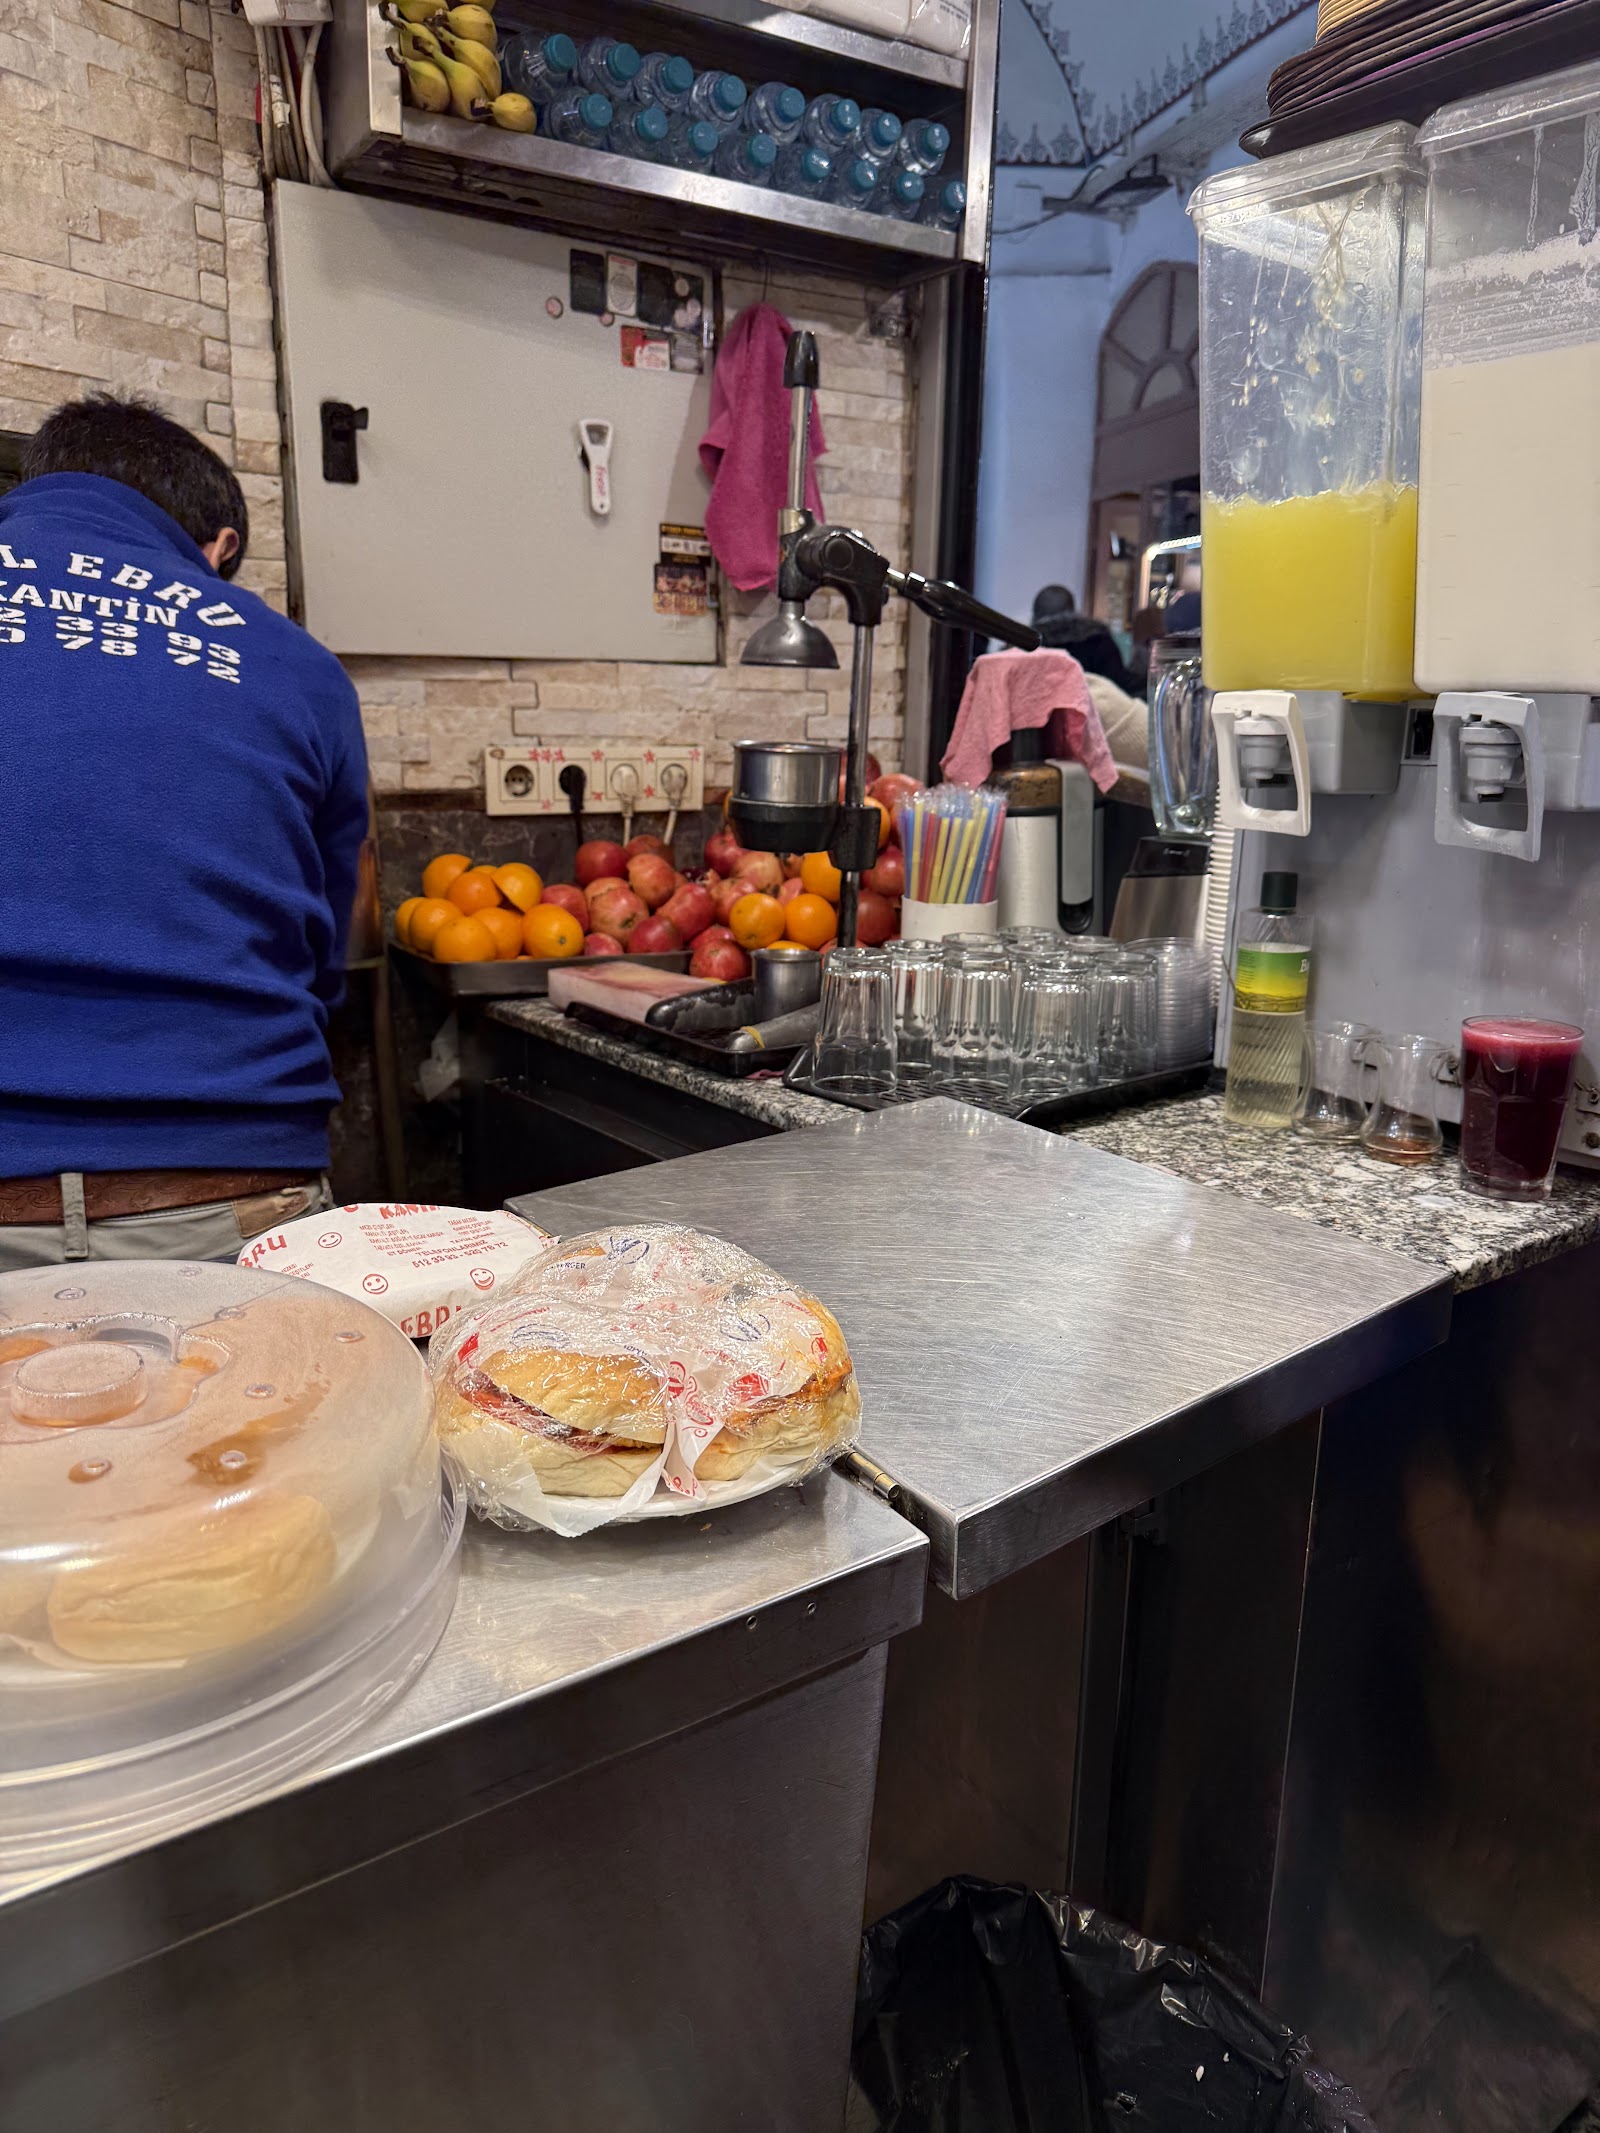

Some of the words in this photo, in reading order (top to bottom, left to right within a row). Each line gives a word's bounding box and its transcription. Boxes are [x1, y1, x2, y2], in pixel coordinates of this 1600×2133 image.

[67, 552, 247, 628] EBRU
[56, 615, 140, 639] 33
[167, 631, 241, 665] 93
[56, 632, 139, 658] 78
[166, 647, 241, 685] 72
[379, 1203, 440, 1220] KAN
[241, 1235, 288, 1268] BRU
[412, 1259, 432, 1268] 512
[431, 1255, 446, 1264] 33
[494, 1241, 509, 1250] 72
[415, 1239, 488, 1257] TELEFONLARIMIZ
[400, 1305, 462, 1337] EBR
